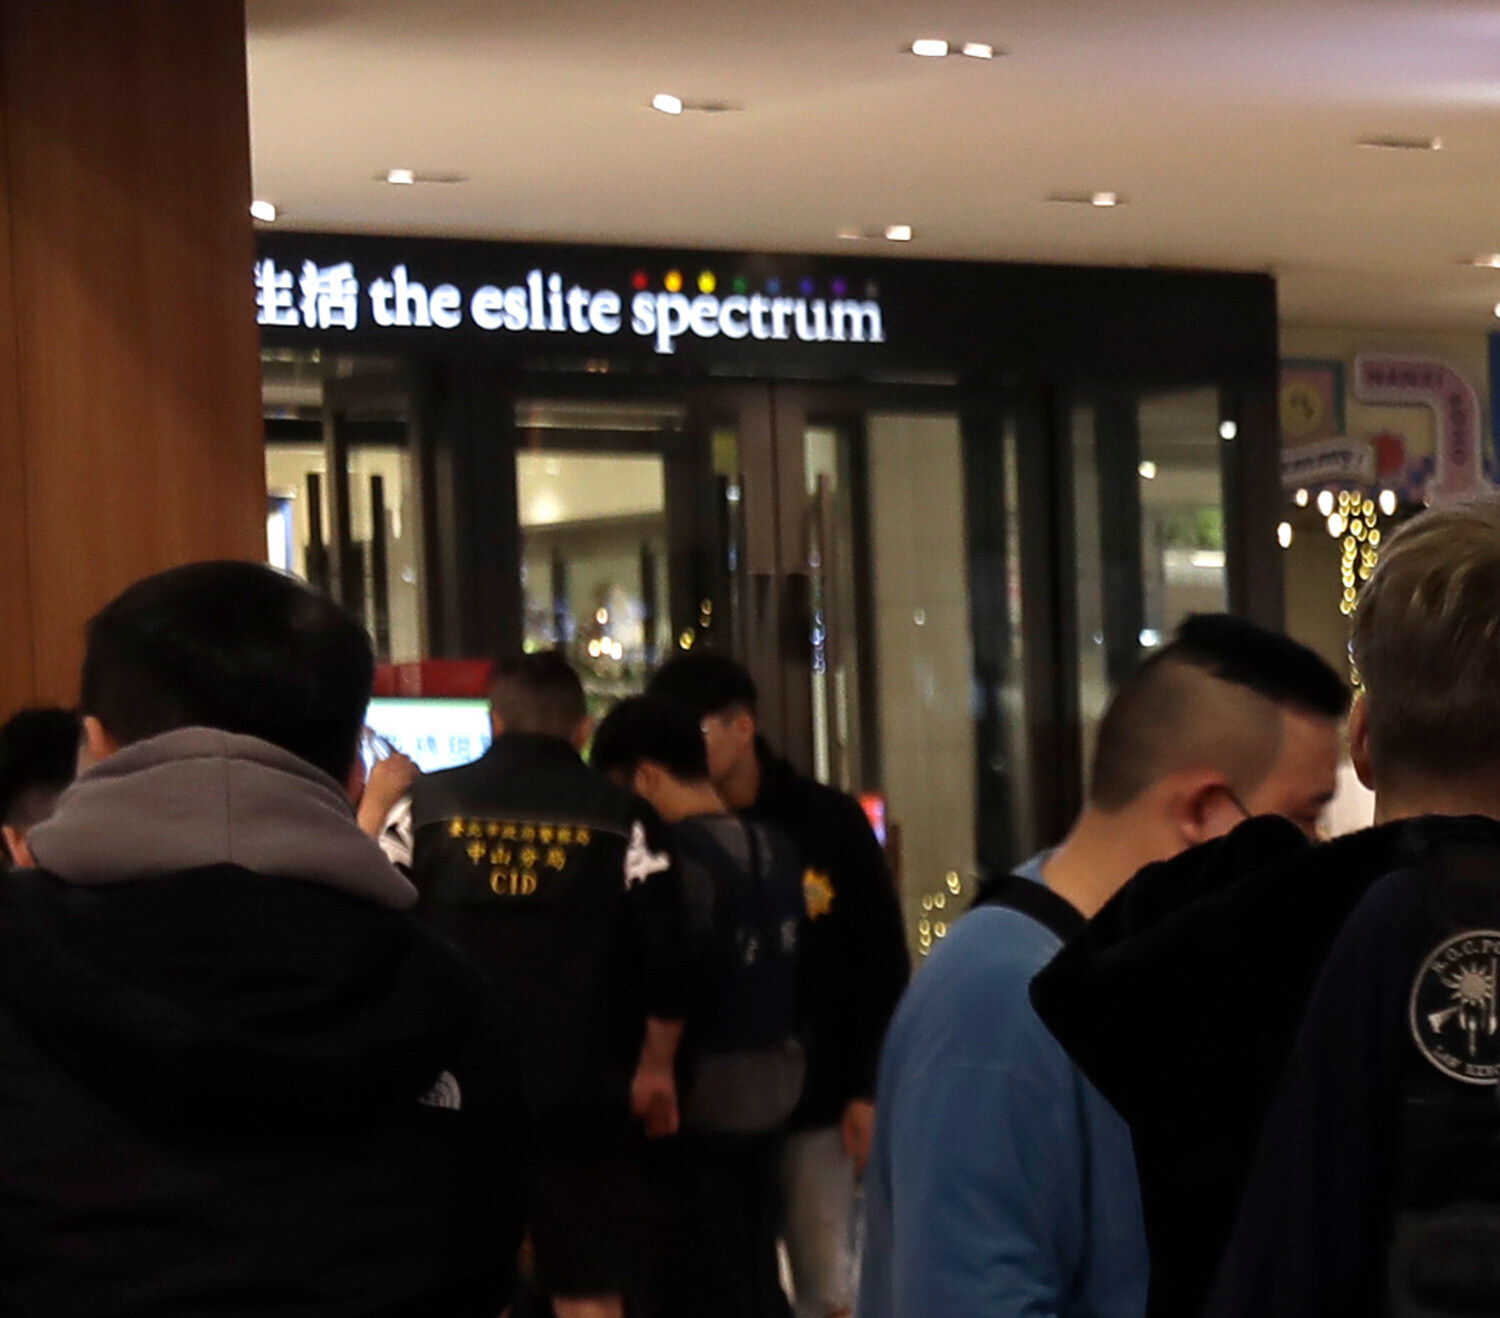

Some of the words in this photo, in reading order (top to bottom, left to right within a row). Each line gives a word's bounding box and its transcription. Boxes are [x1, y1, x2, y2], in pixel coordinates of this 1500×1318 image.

[254, 259, 359, 330] 生活
[369, 264, 461, 328] the
[470, 268, 620, 334] eslite
[631, 291, 885, 354] spectrum
[490, 866, 538, 896] CID
